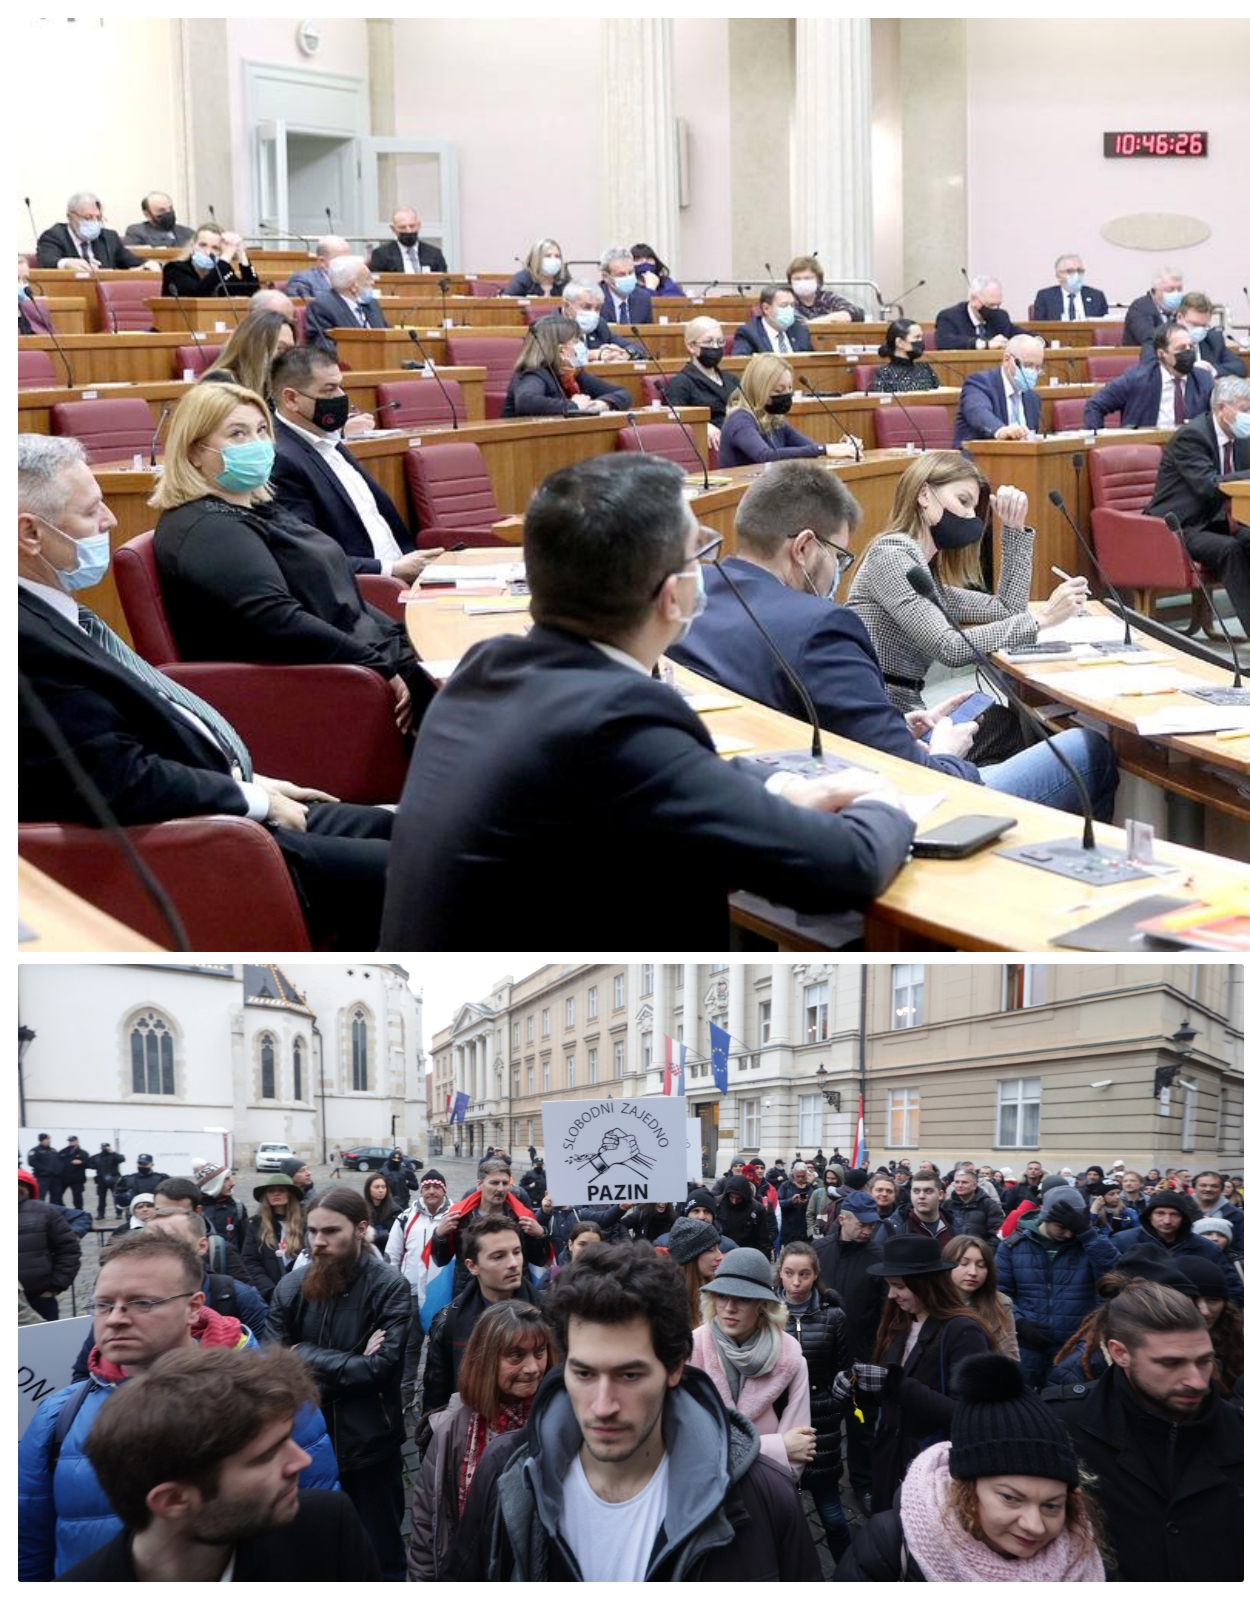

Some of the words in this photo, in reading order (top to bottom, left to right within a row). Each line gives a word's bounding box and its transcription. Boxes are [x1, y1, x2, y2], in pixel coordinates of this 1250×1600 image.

[1115, 133, 1202, 155] 10:46:26
[562, 1102, 614, 1150] SLOBODNI
[620, 1102, 669, 1148] ZAJEDNO
[587, 1183, 648, 1201] PAZIN
